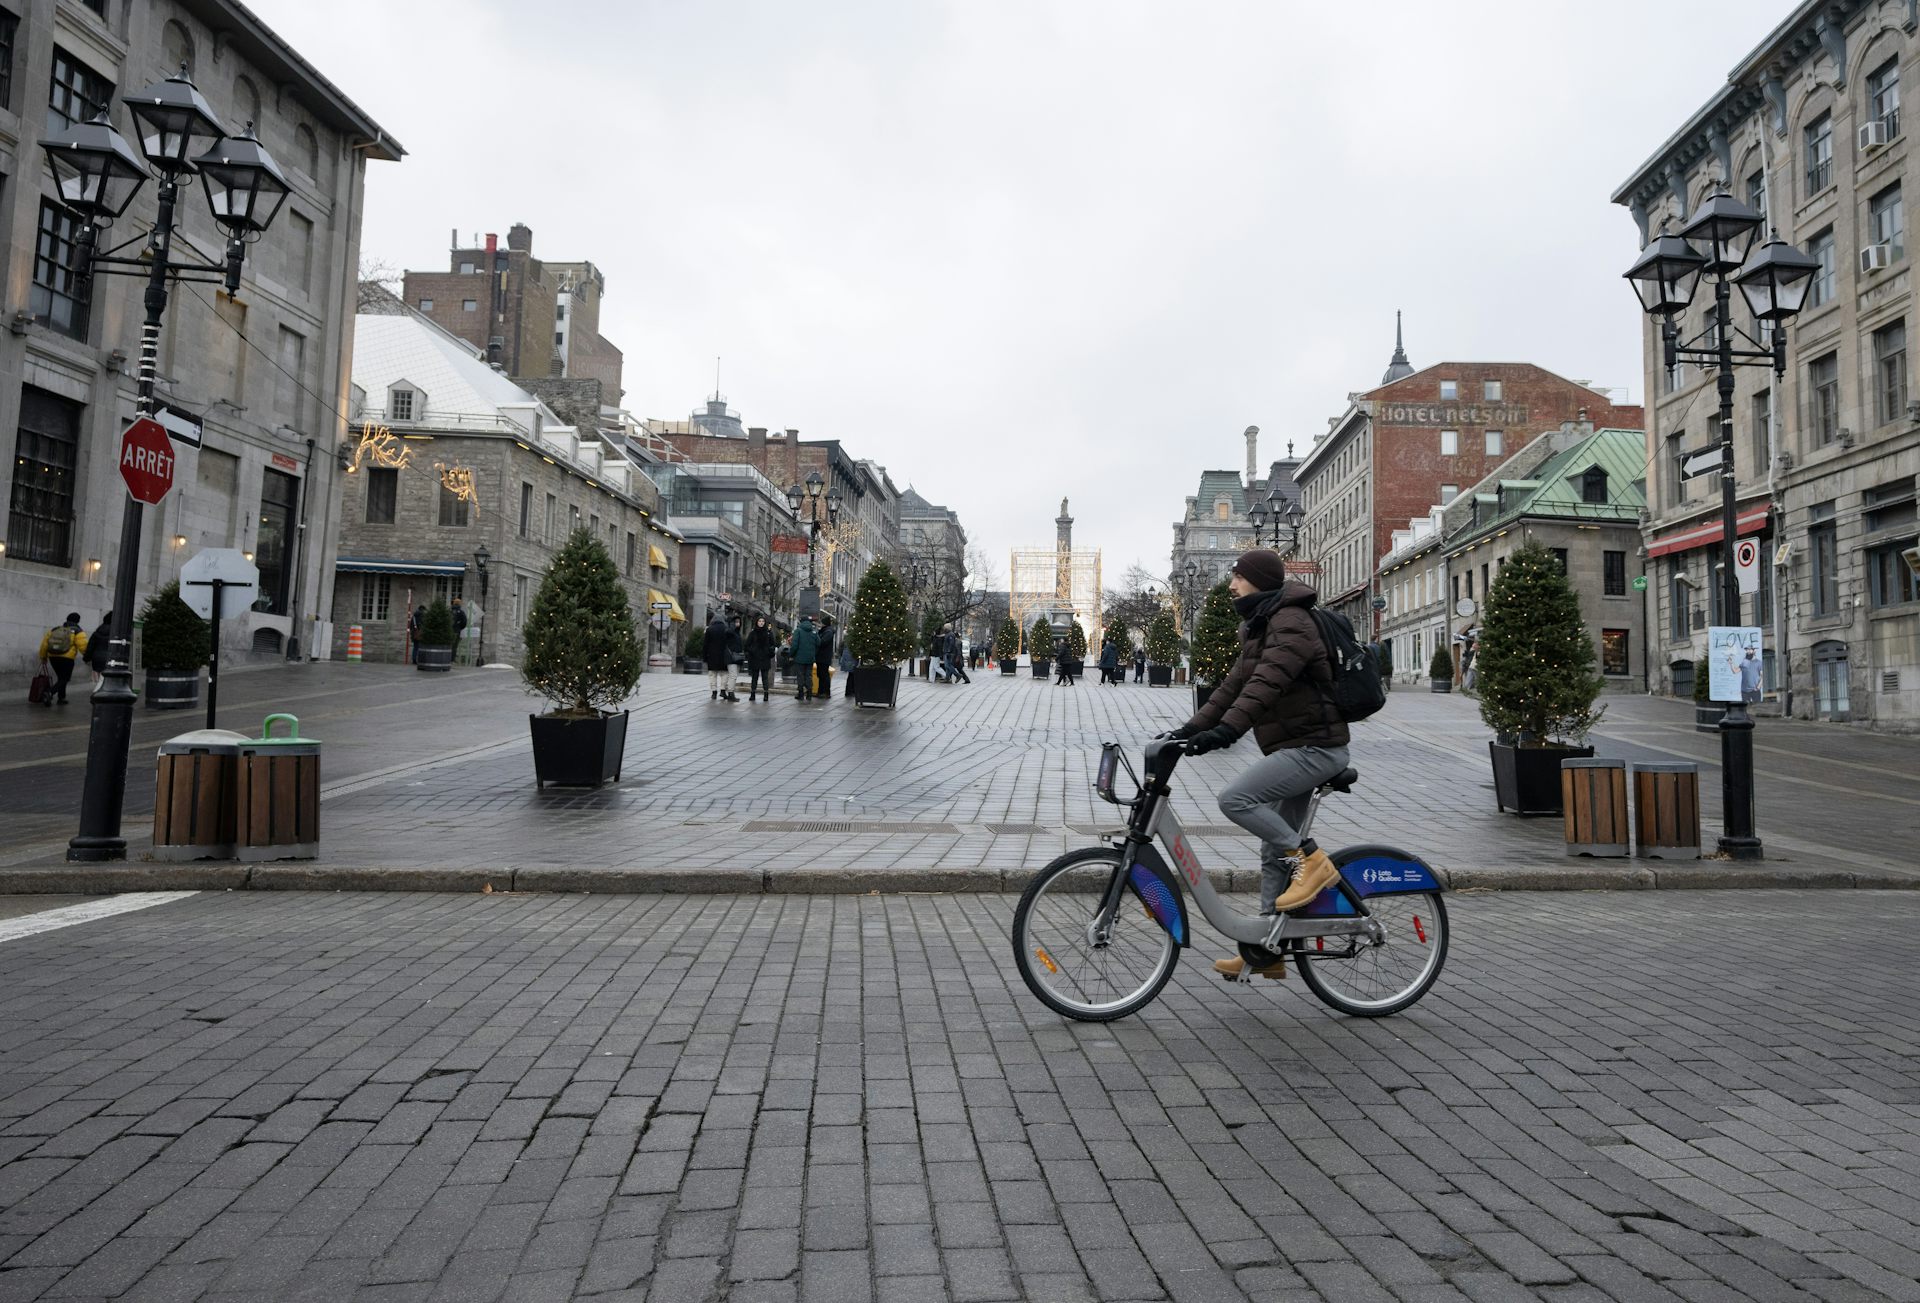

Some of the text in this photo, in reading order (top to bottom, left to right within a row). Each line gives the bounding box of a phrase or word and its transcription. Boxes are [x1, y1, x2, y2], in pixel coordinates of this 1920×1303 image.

[1382, 407, 1441, 422] HOTEL
[122, 443, 173, 480] ARRÊT
[1714, 632, 1759, 648] LOVE
